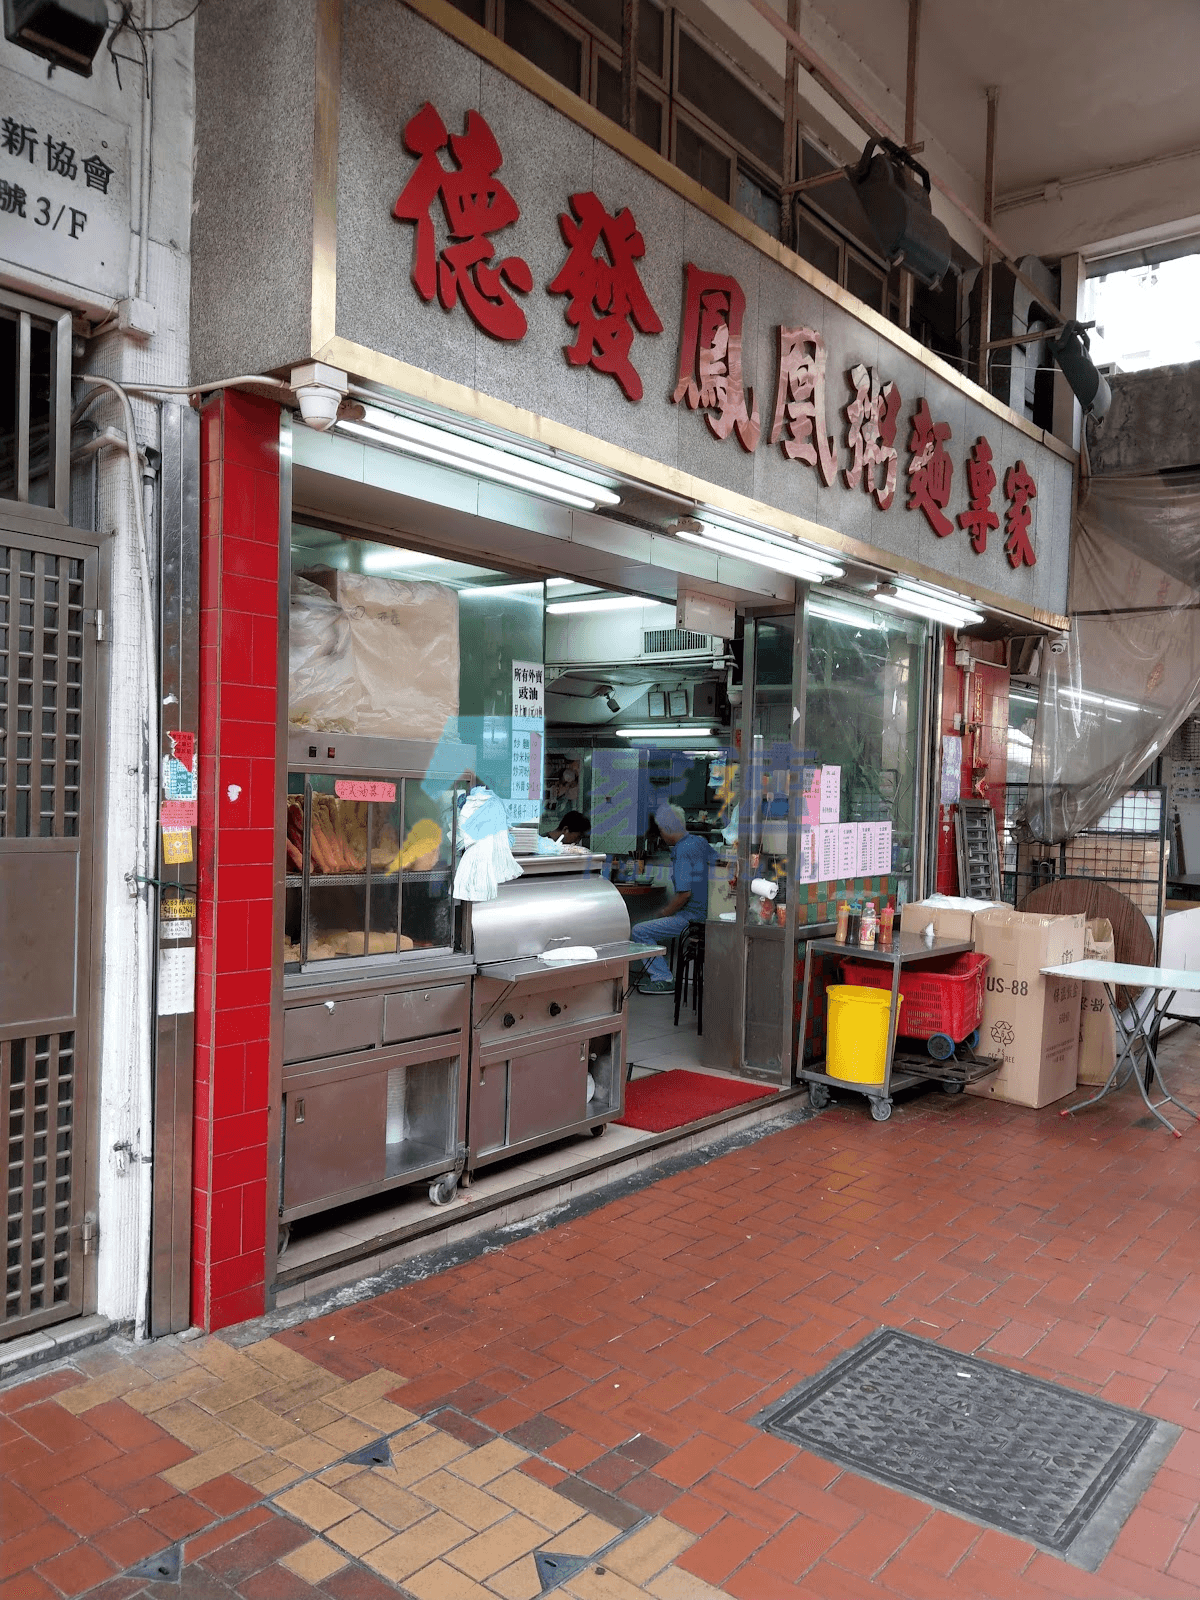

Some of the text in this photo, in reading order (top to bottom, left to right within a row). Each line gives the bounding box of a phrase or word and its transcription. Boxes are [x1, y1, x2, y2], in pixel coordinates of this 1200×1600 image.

[34, 196, 88, 240] 3/F
[391, 101, 1037, 569] 德發鳳凰粥麵專家
[514, 667, 543, 684] 所有外賣
[518, 686, 539, 700] 豉油
[986, 976, 1029, 996] US-88
